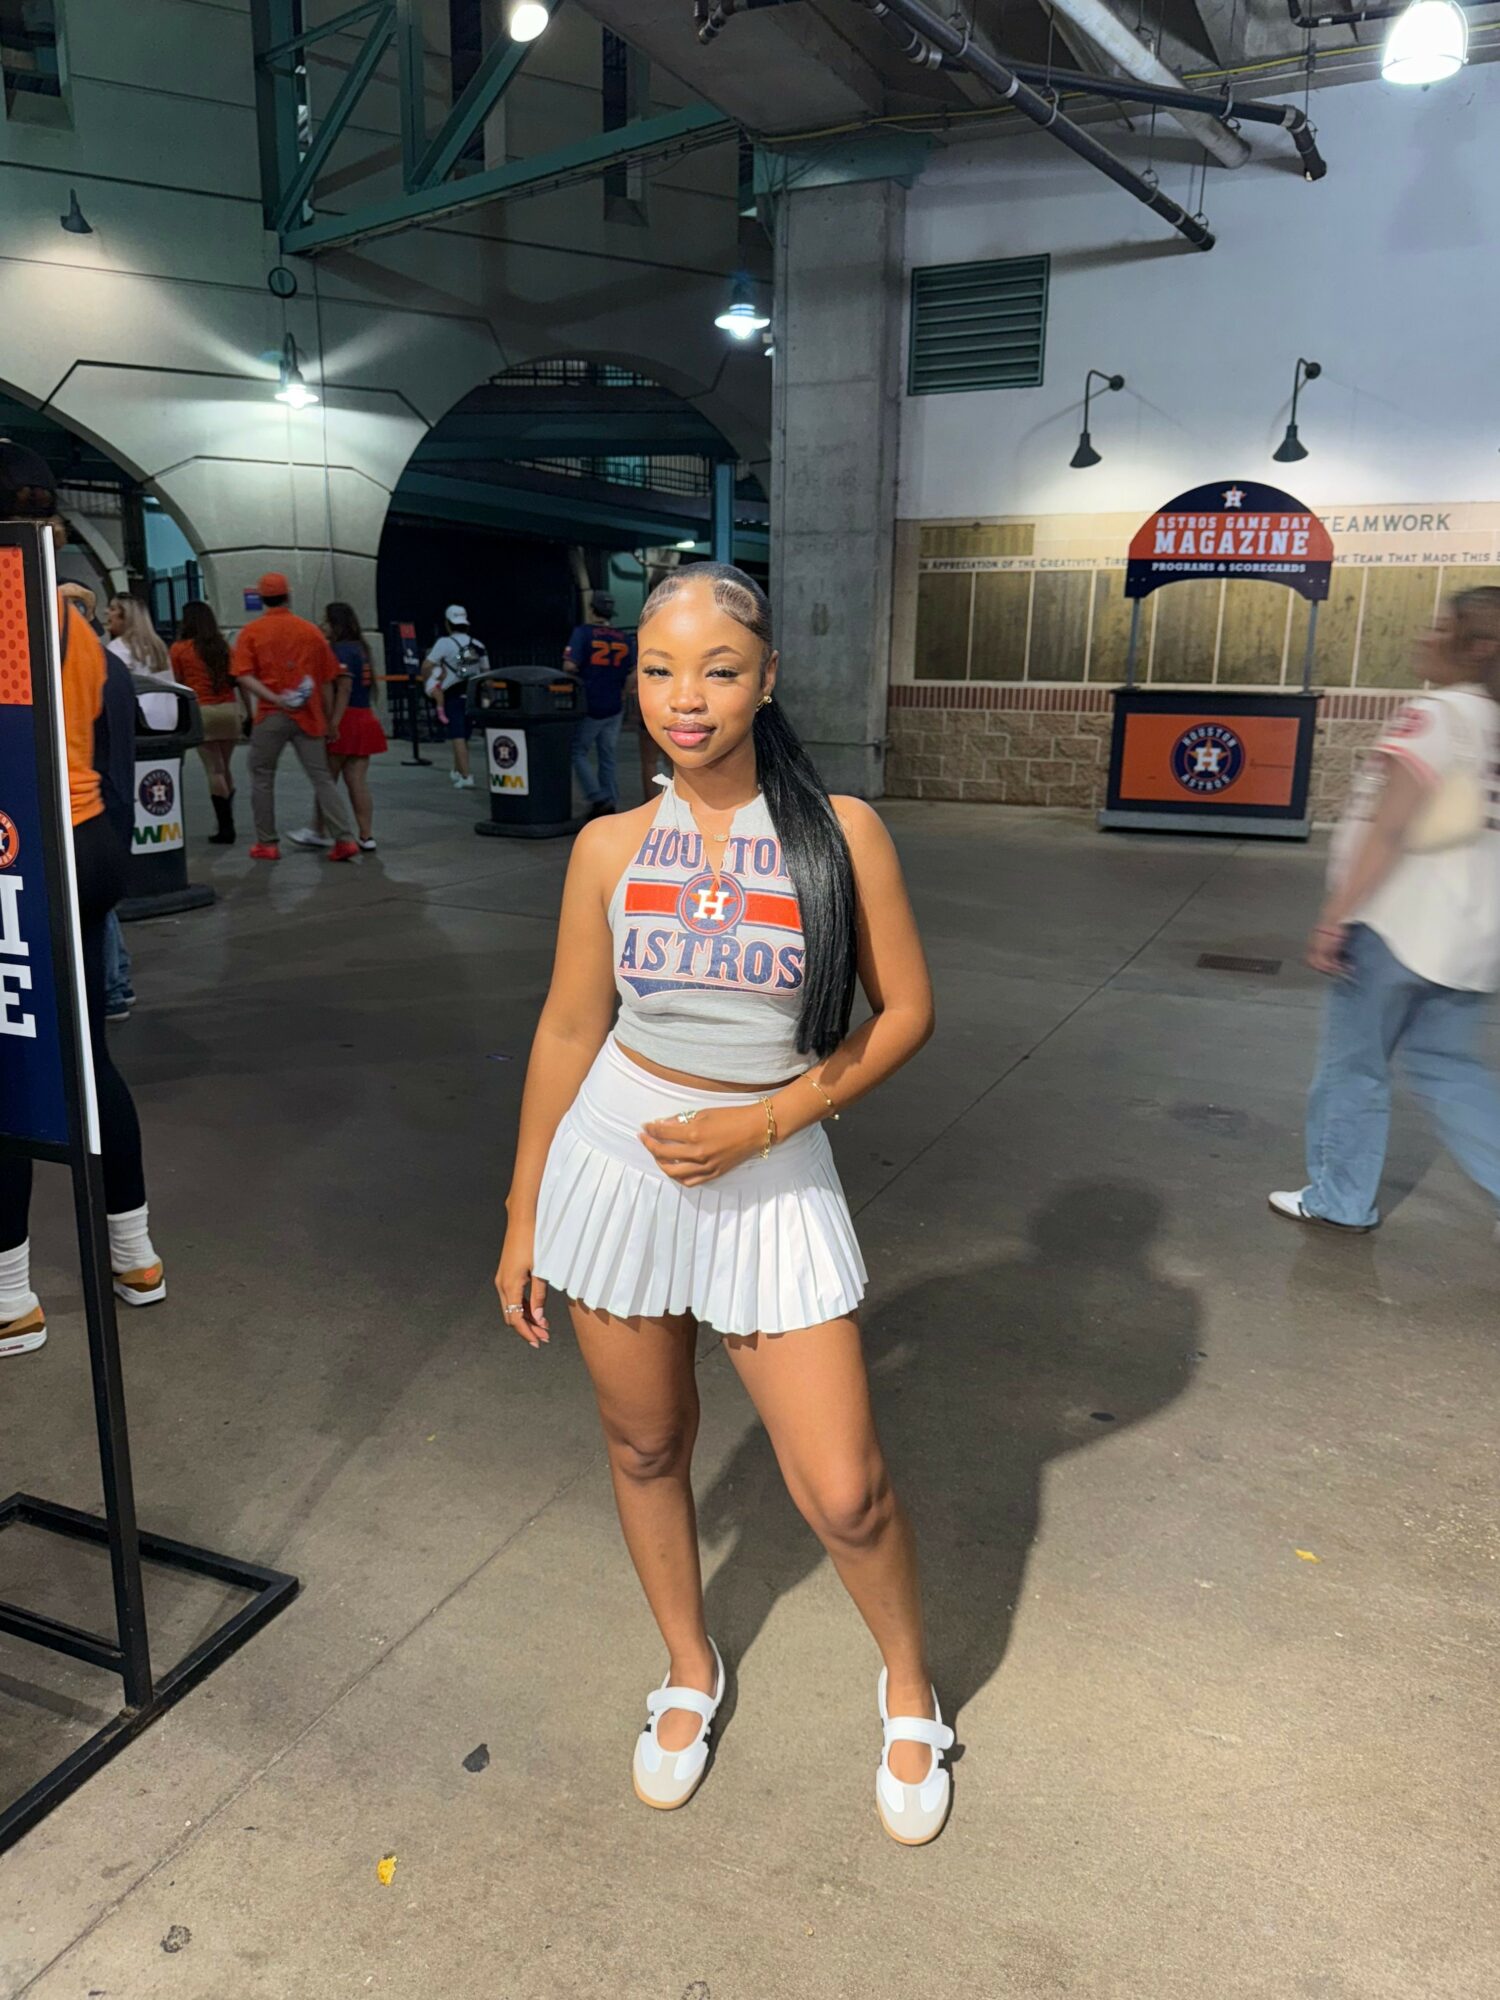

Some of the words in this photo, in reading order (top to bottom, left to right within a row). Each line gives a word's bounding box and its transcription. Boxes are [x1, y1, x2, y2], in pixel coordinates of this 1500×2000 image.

[1156, 516, 1217, 529] ASTROS
[1225, 517, 1271, 529] GAME
[1279, 517, 1312, 529] DAY
[1318, 513, 1451, 532] TEAMWORK
[1153, 530, 1310, 555] MAGAZINE
[1152, 562, 1215, 572] PROGRAMS
[1217, 562, 1226, 571] &
[1229, 563, 1306, 573] SCORECARDS
[591, 640, 628, 667] 27
[634, 827, 791, 880] HOUTO
[619, 927, 806, 990] ASTROS
